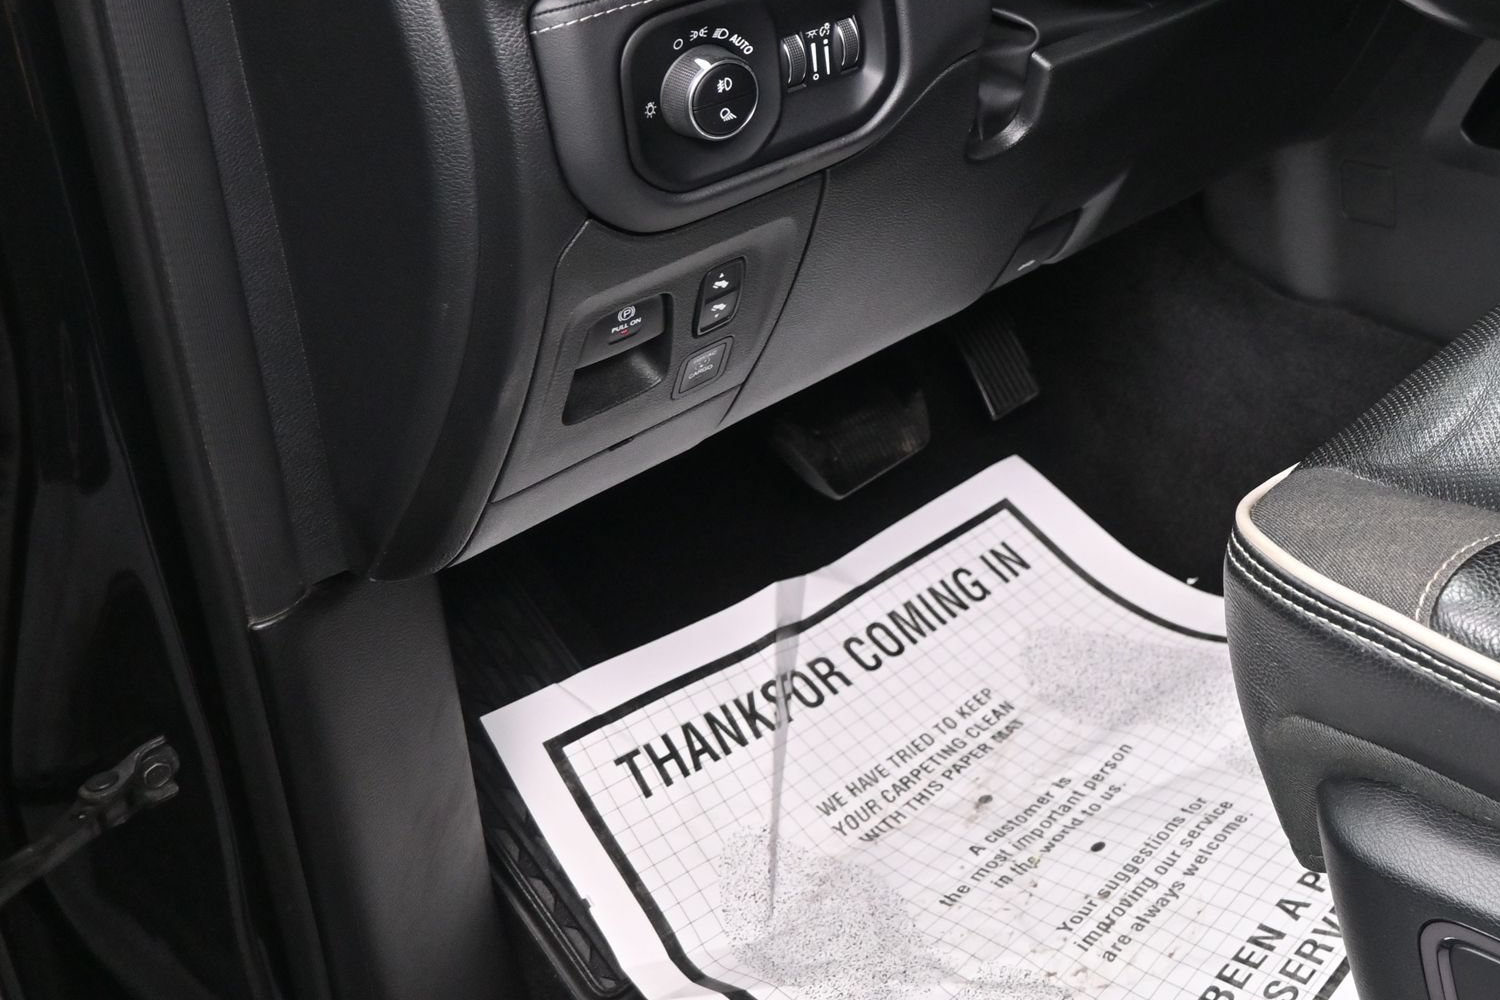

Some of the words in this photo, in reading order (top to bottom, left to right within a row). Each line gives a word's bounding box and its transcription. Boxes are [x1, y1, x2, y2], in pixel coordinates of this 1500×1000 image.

[729, 34, 754, 55] AUTO
[611, 323, 629, 334] PULL
[630, 317, 642, 326] ON
[613, 677, 784, 799] THANKS
[843, 567, 991, 671] COMING
[979, 542, 1031, 583] IN
[816, 791, 848, 817] WE
[845, 763, 891, 797] HAVE
[887, 733, 935, 768] TRIED
[933, 716, 958, 736] TO
[955, 687, 993, 720] KEEP
[832, 799, 883, 837] YOUR
[880, 737, 967, 804] CARPETING
[965, 700, 1015, 739] CLEAN
[858, 810, 907, 843] WITH
[903, 780, 944, 812] THIS
[941, 743, 994, 781] PAPER
[990, 718, 1024, 743] MAT
[939, 884, 971, 908] the
[970, 849, 1014, 883] most
[1007, 790, 1086, 851] important
[1083, 743, 1133, 791] person
[968, 844, 986, 856] A
[984, 791, 1054, 844] customer
[991, 873, 1014, 889] in
[1010, 855, 1041, 877] the
[1040, 817, 1083, 854] world
[1081, 801, 1102, 817] to
[1100, 782, 1127, 802] us.
[1056, 899, 1098, 934] Your
[1097, 815, 1186, 900] suggestions
[1180, 796, 1208, 815] for
[1073, 875, 1159, 952] improving
[1154, 849, 1182, 876] our
[1180, 800, 1233, 848] service
[1101, 934, 1132, 963] are
[1130, 880, 1185, 933] always
[1183, 812, 1254, 878] welcome.
[1275, 898, 1311, 921] A
[1262, 904, 1343, 1000] SERV
